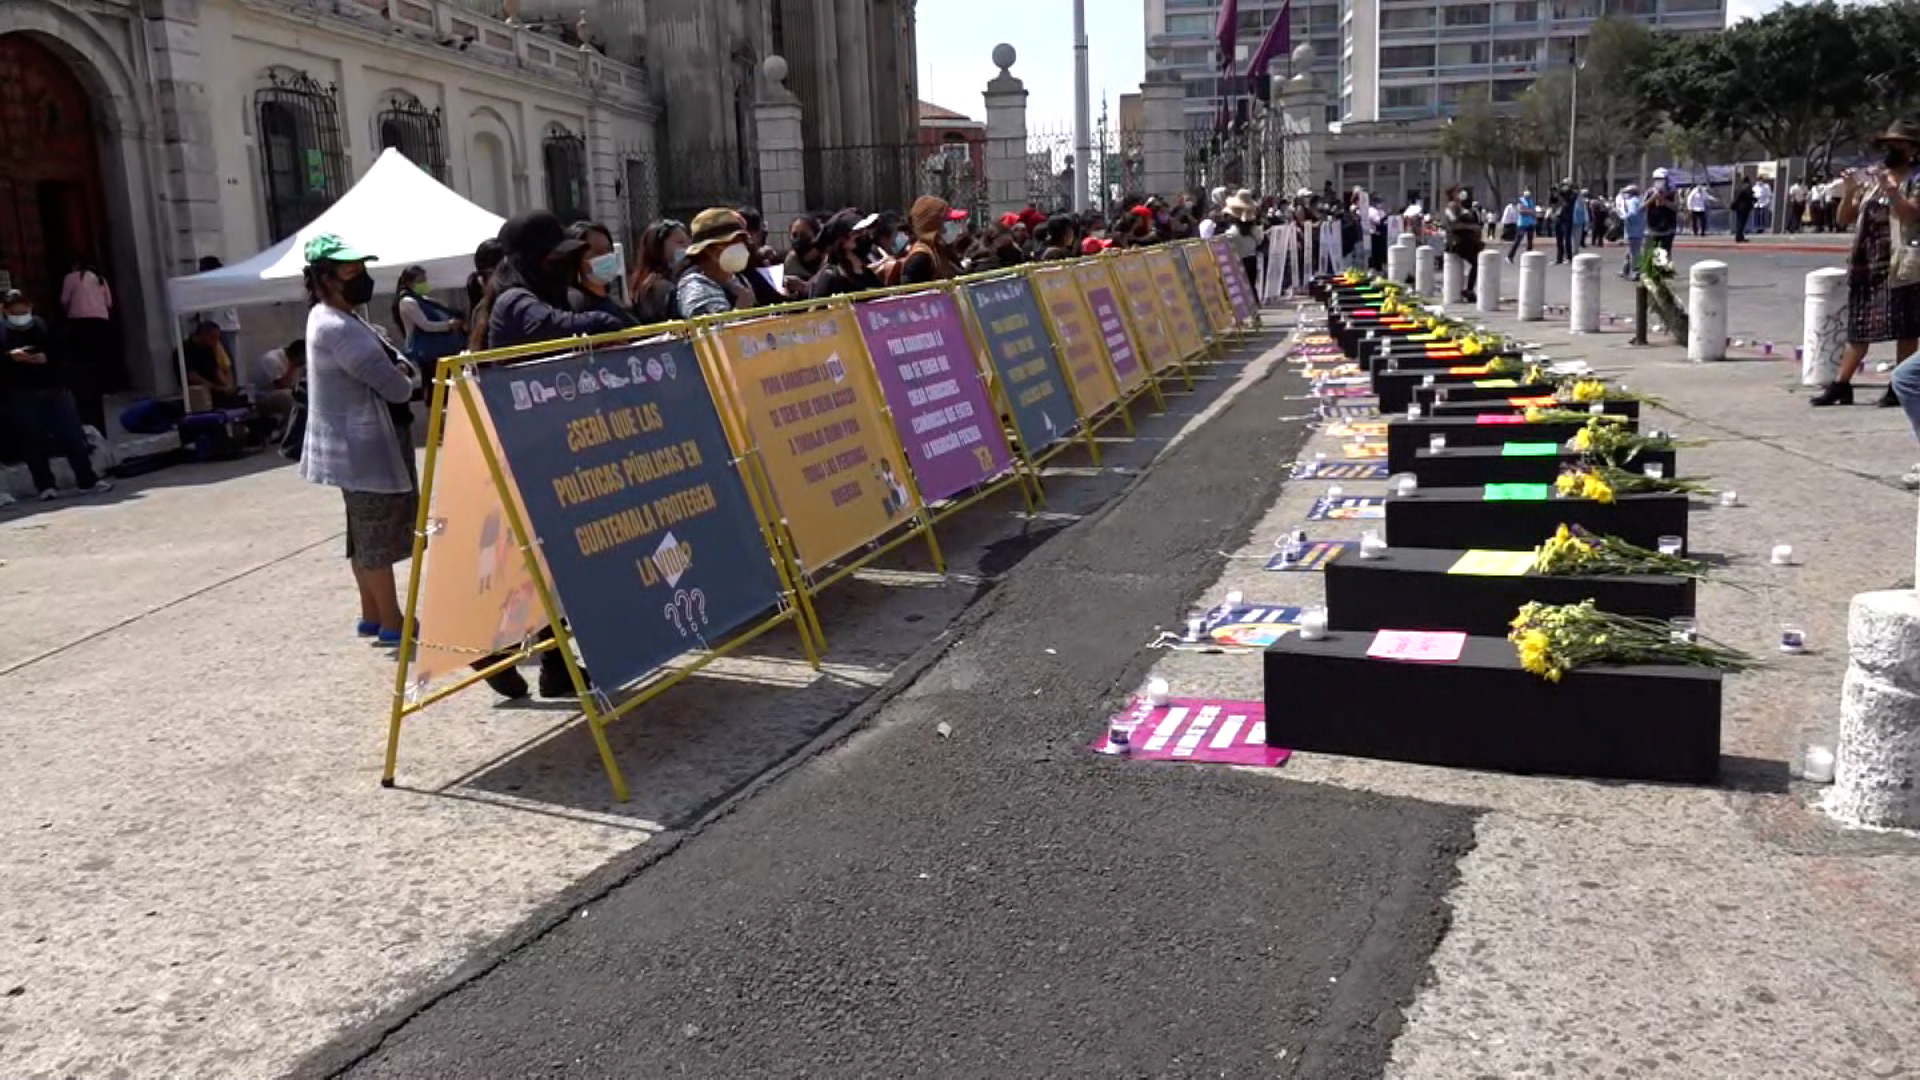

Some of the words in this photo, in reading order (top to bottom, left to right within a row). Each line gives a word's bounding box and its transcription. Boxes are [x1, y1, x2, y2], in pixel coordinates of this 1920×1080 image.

[567, 408, 612, 452] ¿SERÁ
[608, 406, 636, 440] QUE
[635, 402, 664, 433] LAS
[552, 465, 625, 508] POLÍTICAS
[622, 450, 684, 486] PÚBLICAS
[680, 439, 703, 468] EN
[574, 503, 658, 557] GUATEMALA
[653, 482, 717, 527] PROTEGEN
[635, 555, 660, 587] LA
